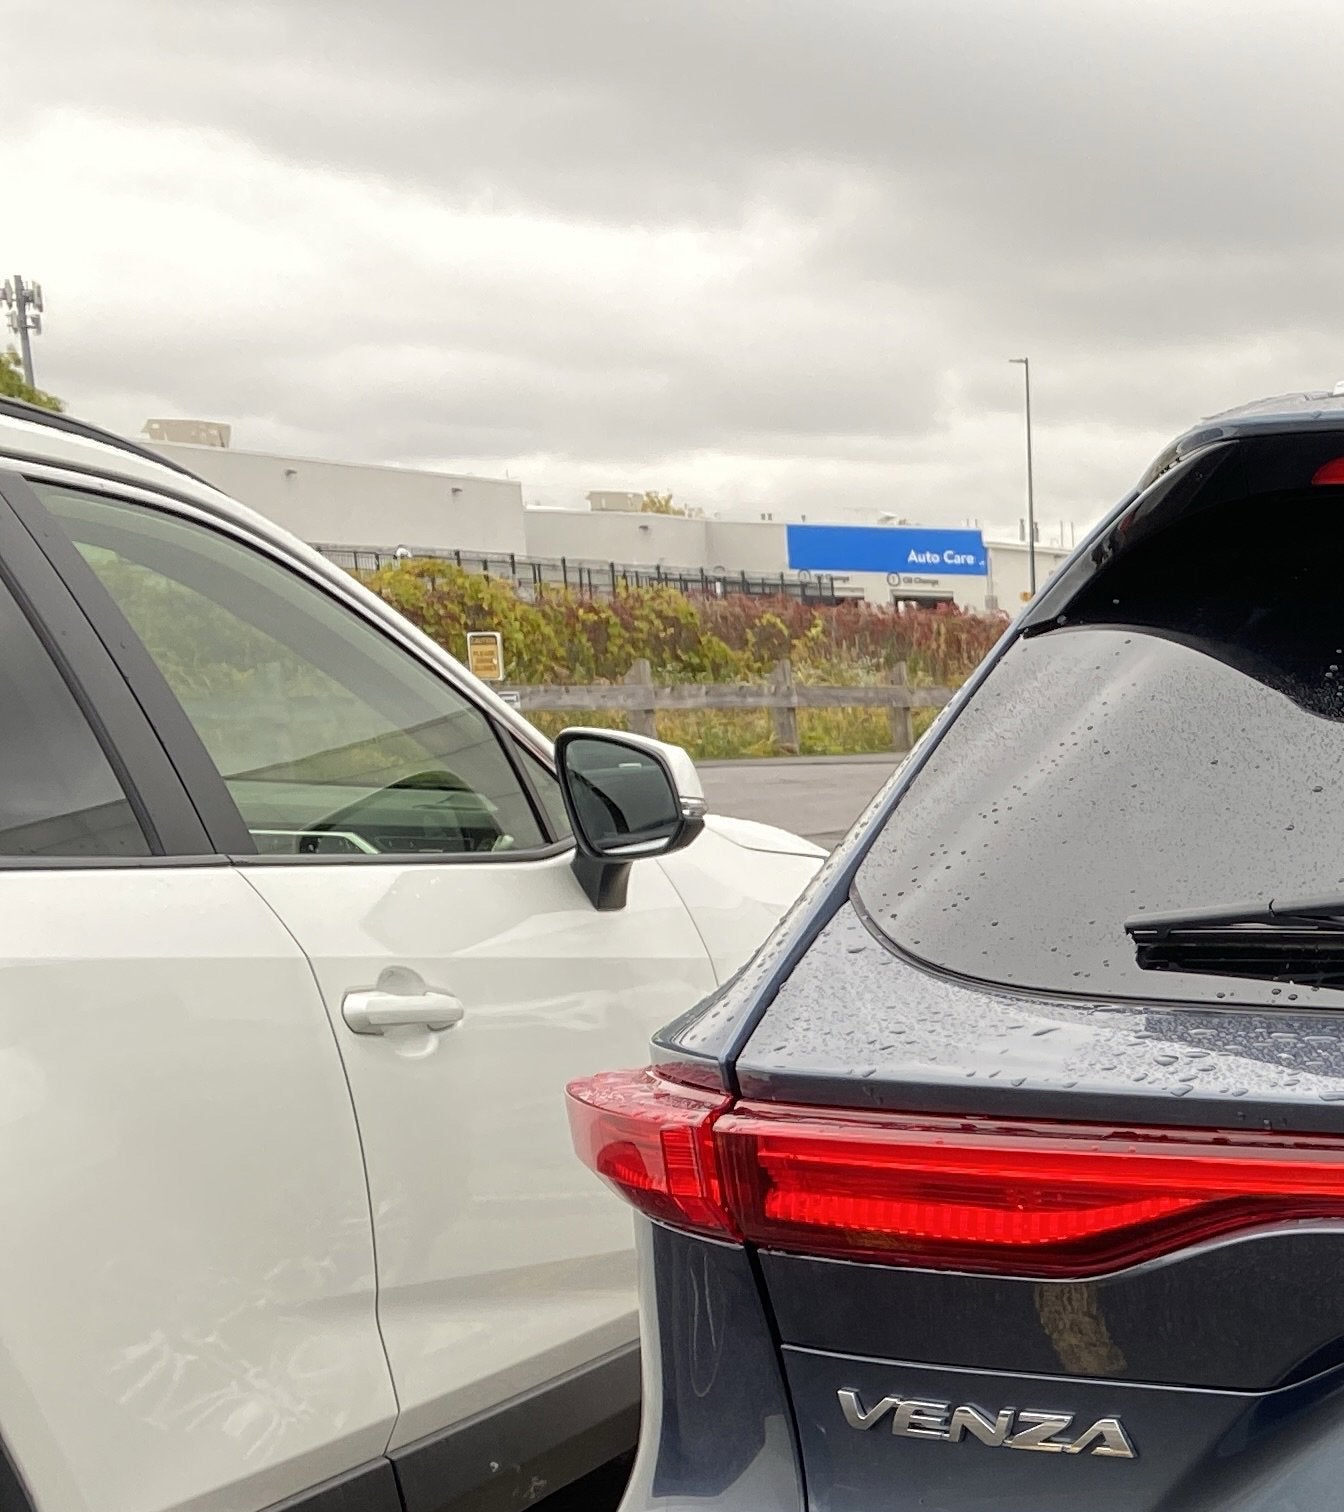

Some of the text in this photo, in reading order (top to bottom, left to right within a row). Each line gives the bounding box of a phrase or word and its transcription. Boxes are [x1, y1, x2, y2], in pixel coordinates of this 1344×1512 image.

[907, 549, 975, 565] Auto Care
[837, 1386, 1138, 1459] VENZA
